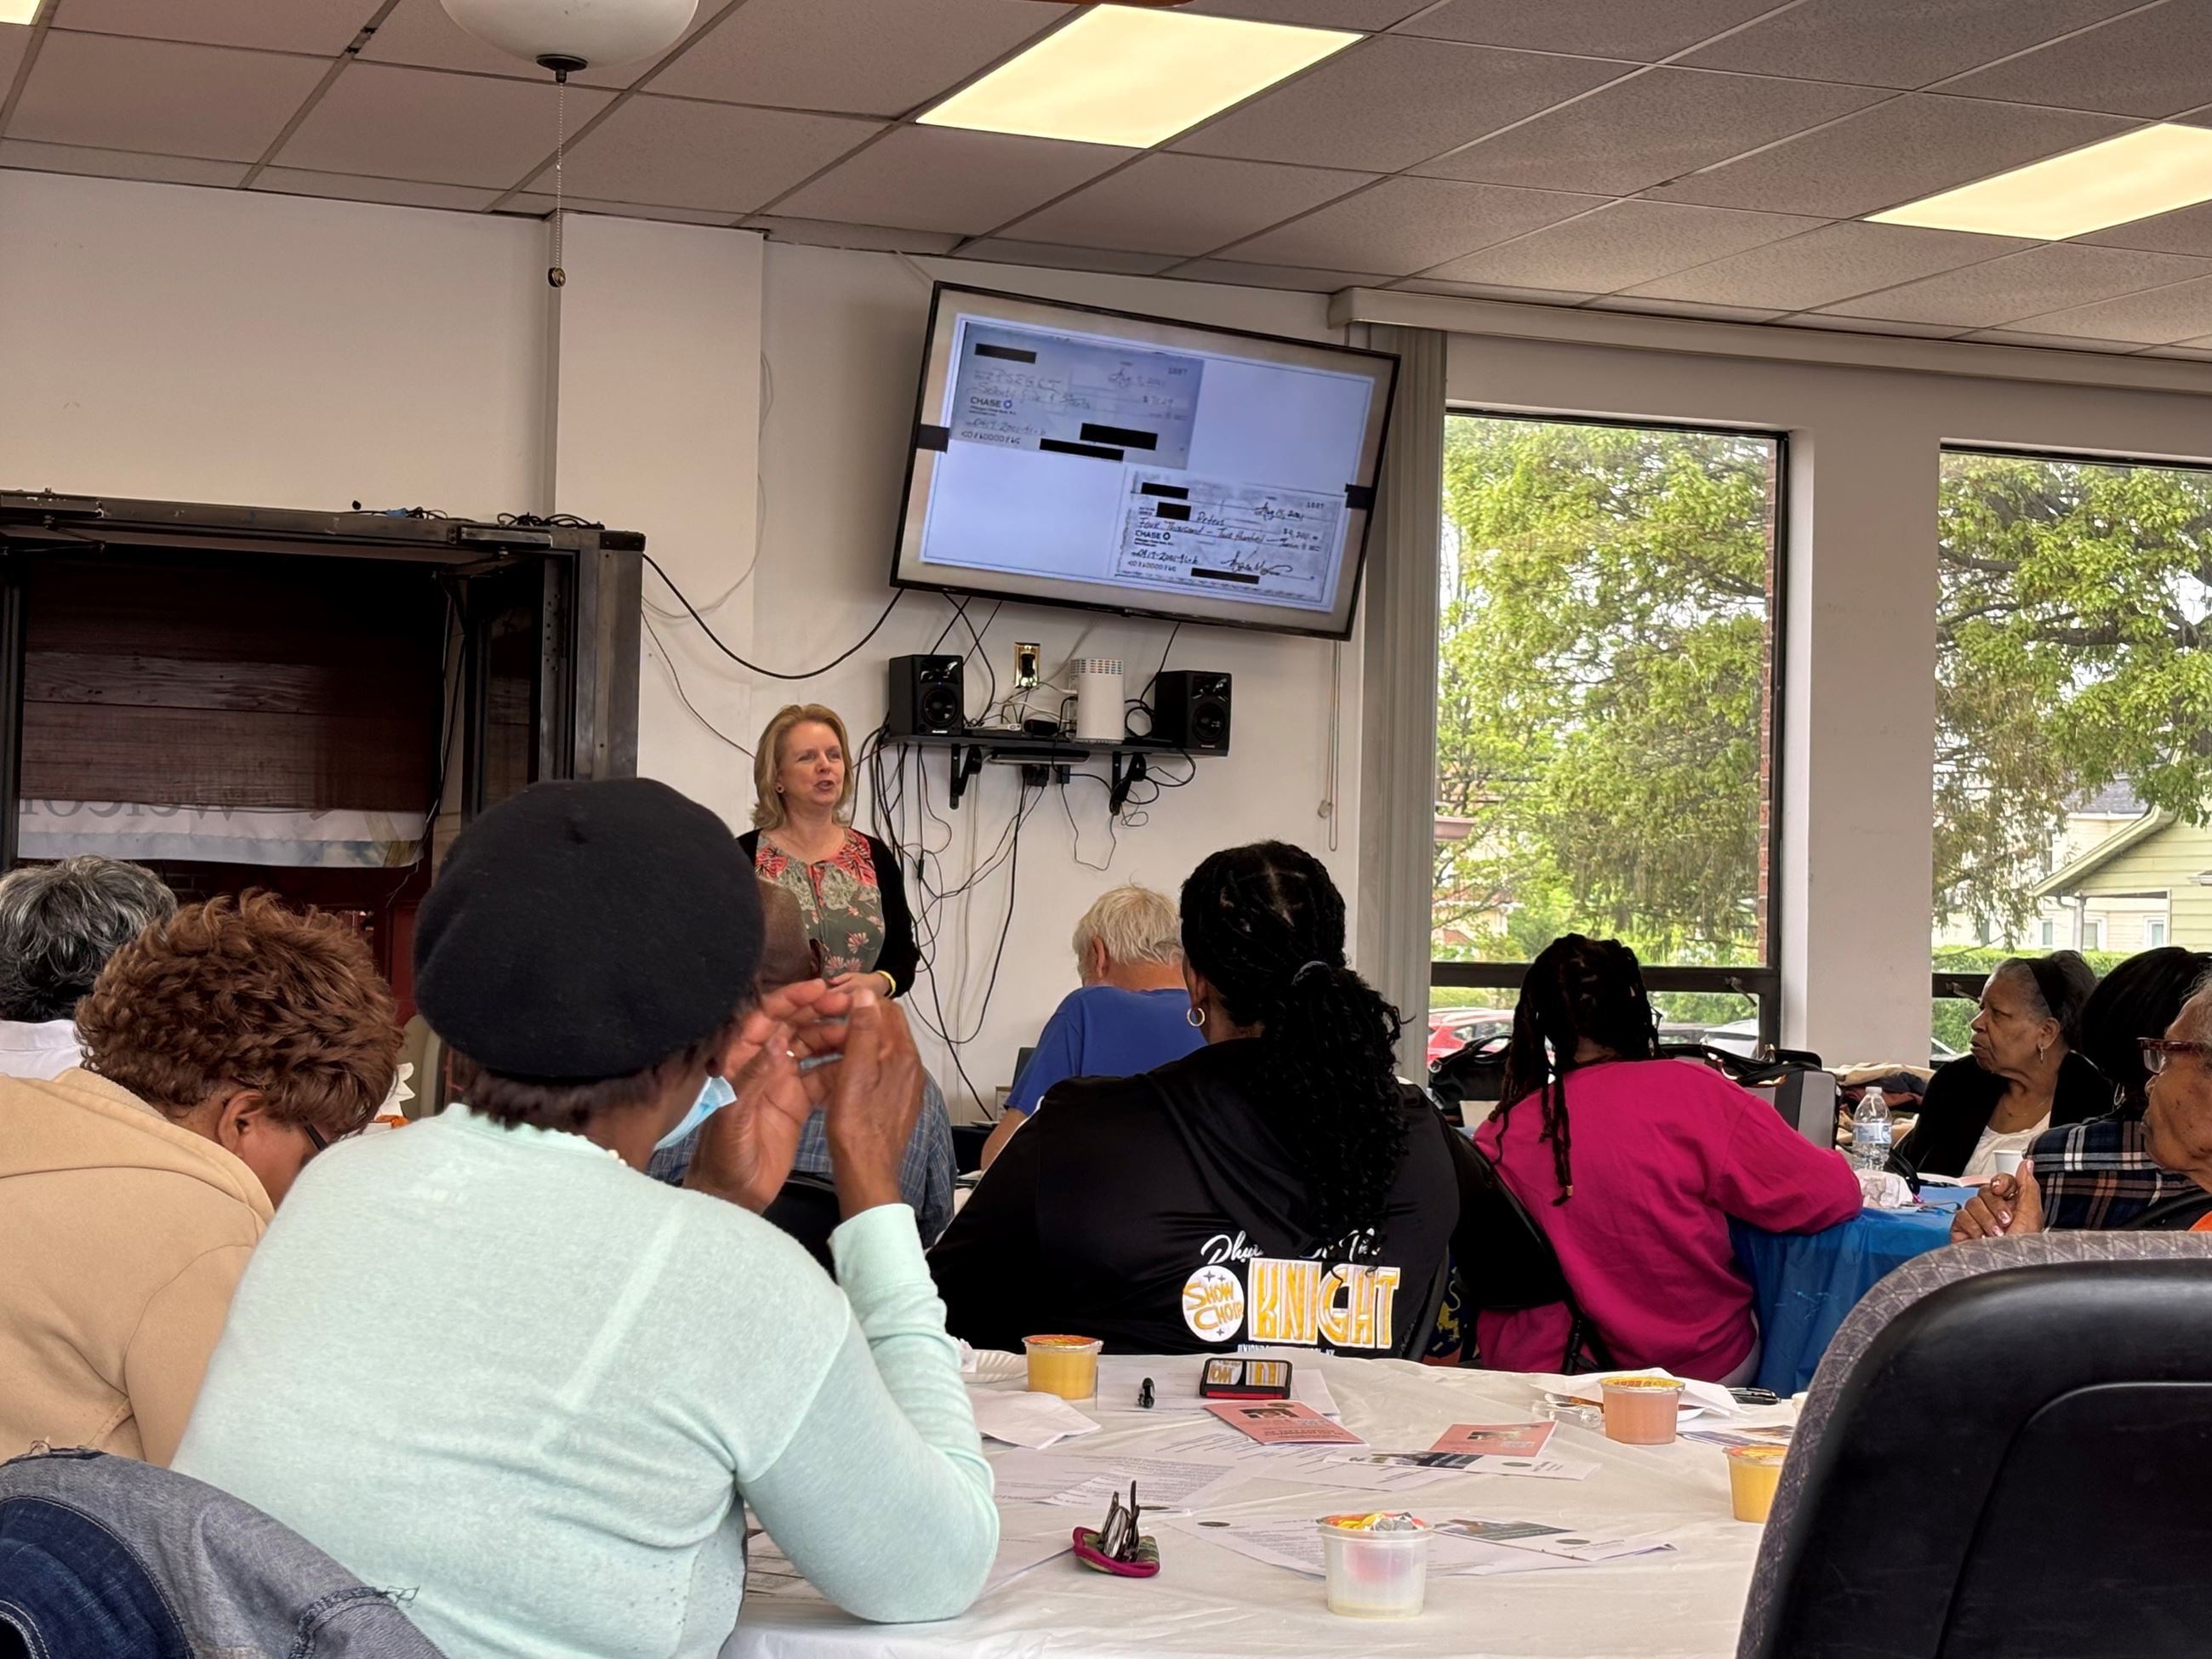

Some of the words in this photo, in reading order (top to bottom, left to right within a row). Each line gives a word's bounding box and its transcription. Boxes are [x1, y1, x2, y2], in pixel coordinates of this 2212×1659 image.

[970, 396, 1002, 408] CHASE
[1135, 529, 1161, 539] CHASE
[1183, 1280, 1234, 1311] SHOW
[1247, 1257, 1401, 1349] KNIGHT
[1194, 1301, 1243, 1331] CHOIR
